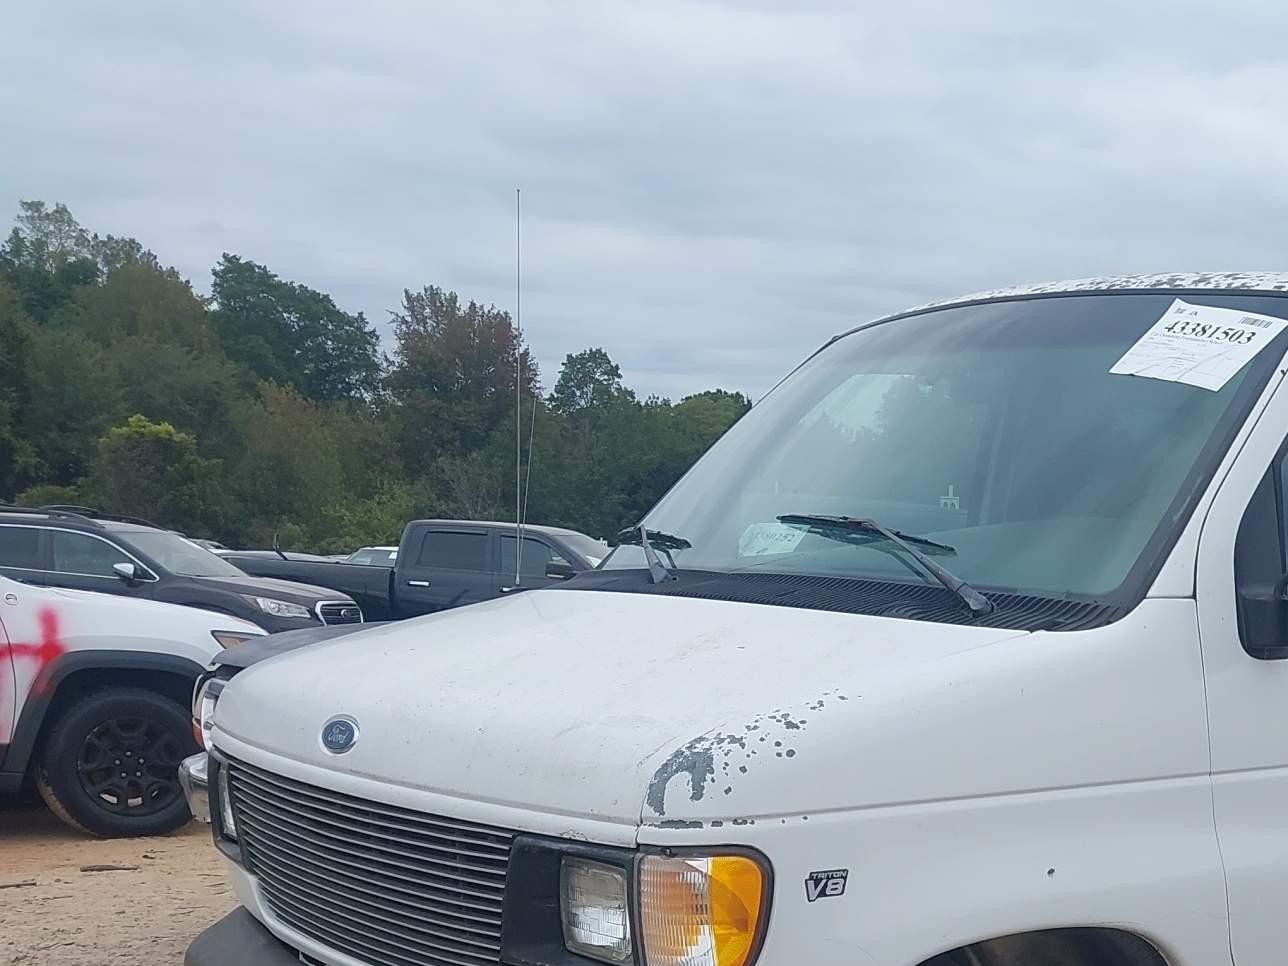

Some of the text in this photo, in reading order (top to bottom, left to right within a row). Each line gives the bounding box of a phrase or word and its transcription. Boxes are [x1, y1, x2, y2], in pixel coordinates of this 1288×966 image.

[1164, 320, 1256, 344] 43381503
[327, 724, 350, 743] Ford
[807, 877, 845, 900] V8
